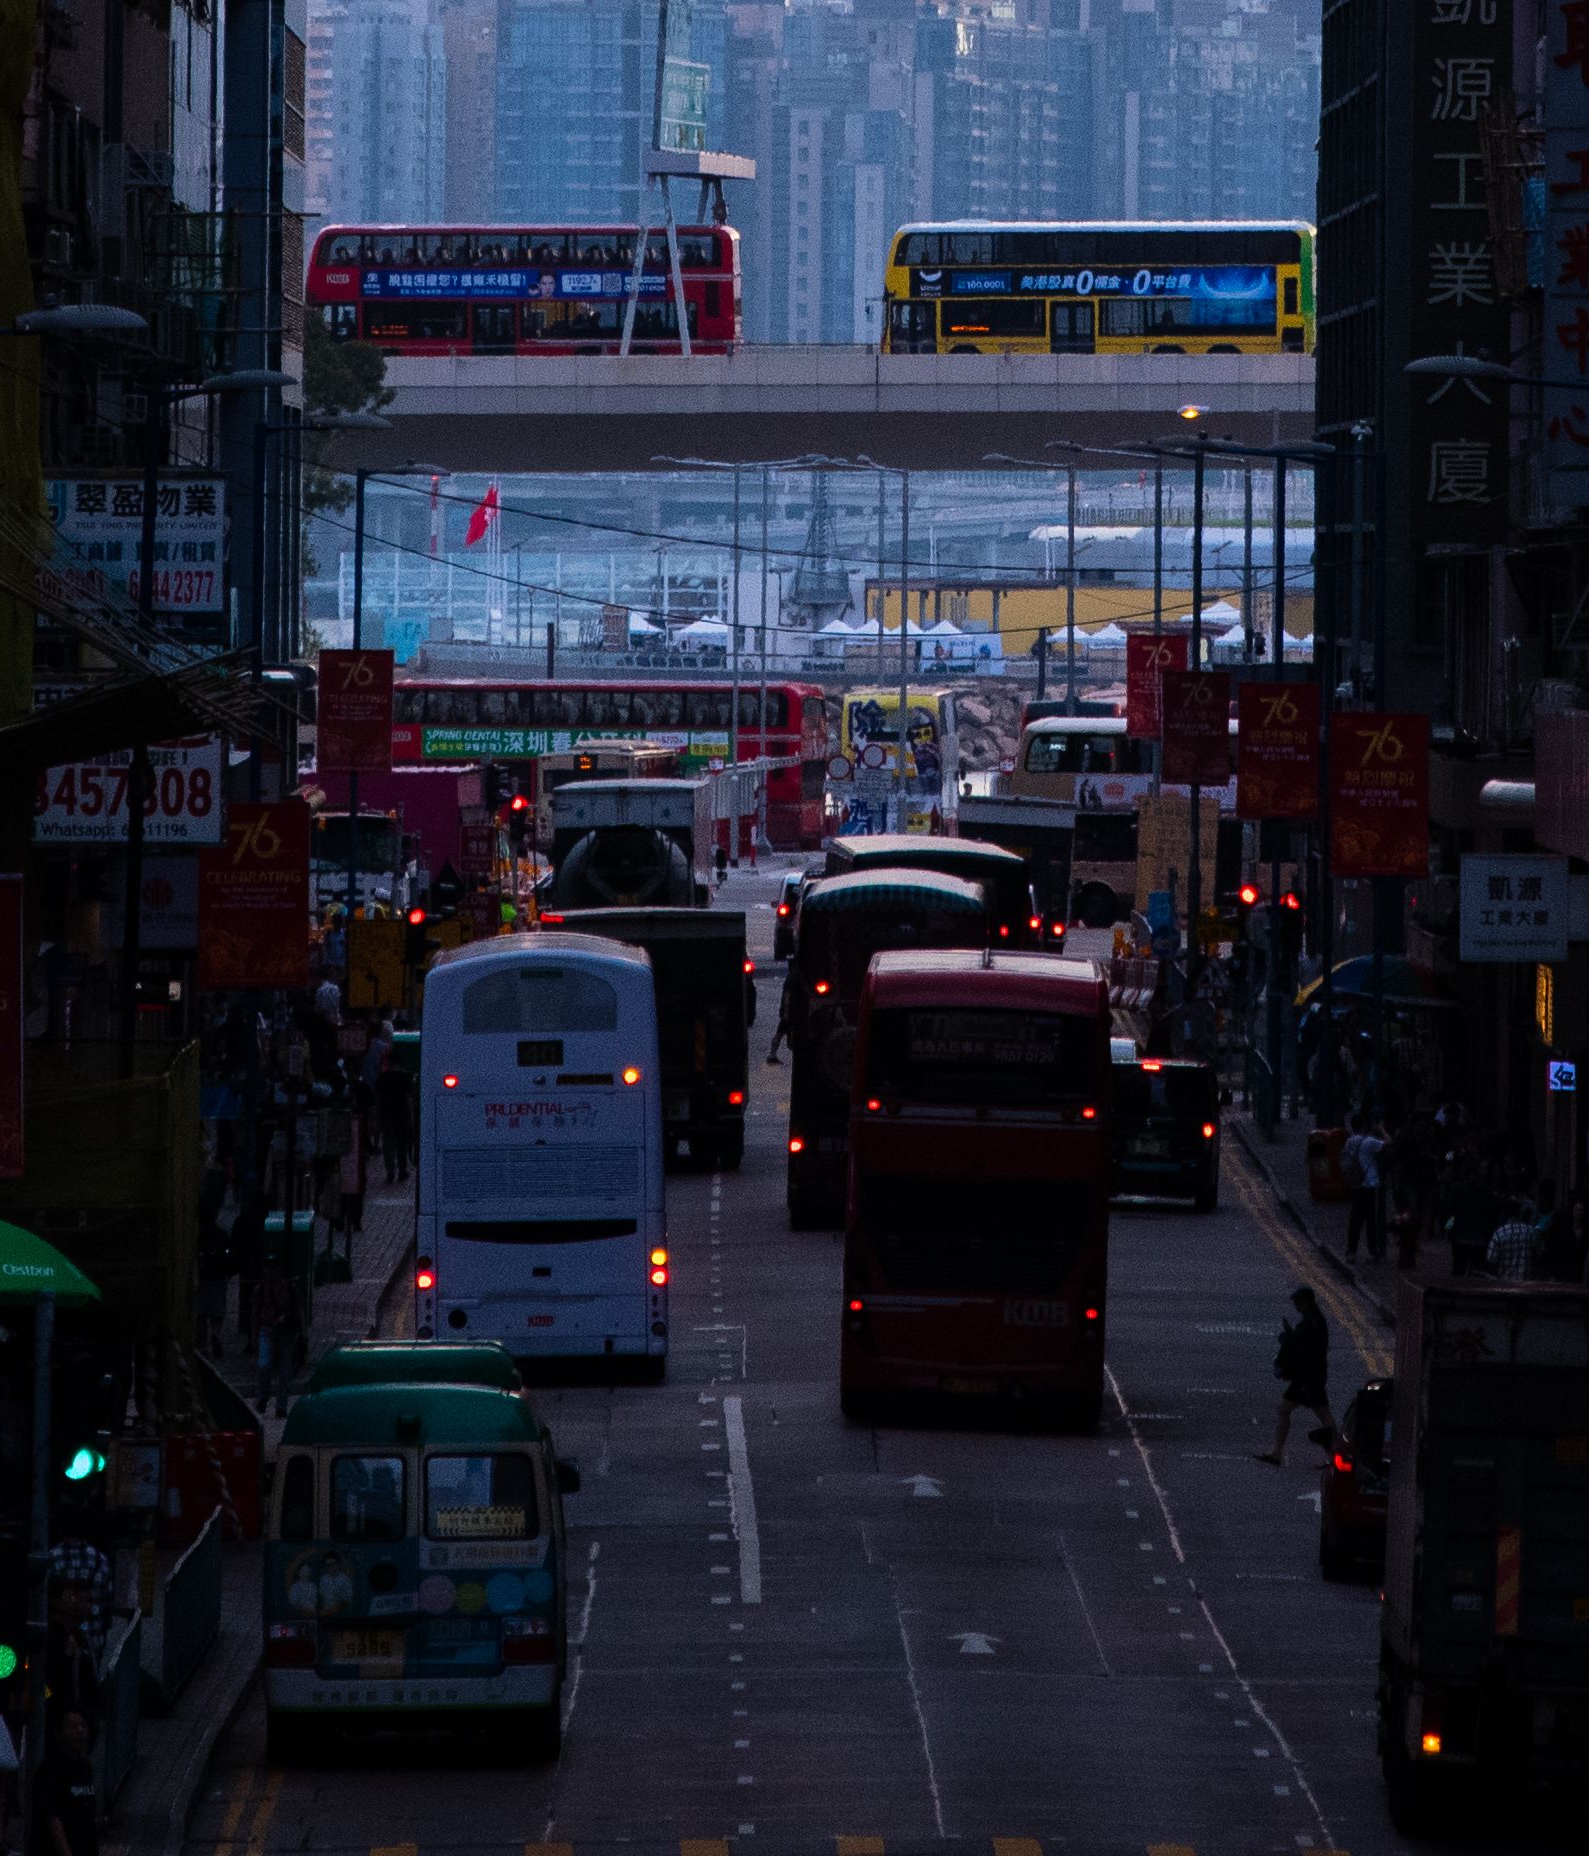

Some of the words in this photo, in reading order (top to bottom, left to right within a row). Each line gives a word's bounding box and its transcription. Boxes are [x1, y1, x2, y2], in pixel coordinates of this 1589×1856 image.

[76, 484, 216, 517] 翠盈物業
[129, 570, 169, 603] 644
[174, 570, 214, 604] 2377
[338, 655, 374, 691] 76
[1260, 689, 1299, 727] 76
[1356, 720, 1404, 766] 76
[41, 823, 115, 839] Whatsapp:
[121, 824, 188, 837] 611196
[229, 810, 282, 865] 76
[206, 871, 301, 885] CELEBRATING
[1488, 876, 1542, 901] 凱源
[1480, 909, 1549, 927] 工業大廈
[484, 1102, 565, 1117] PRUDENTIAL
[1004, 1299, 1069, 1328] KMB
